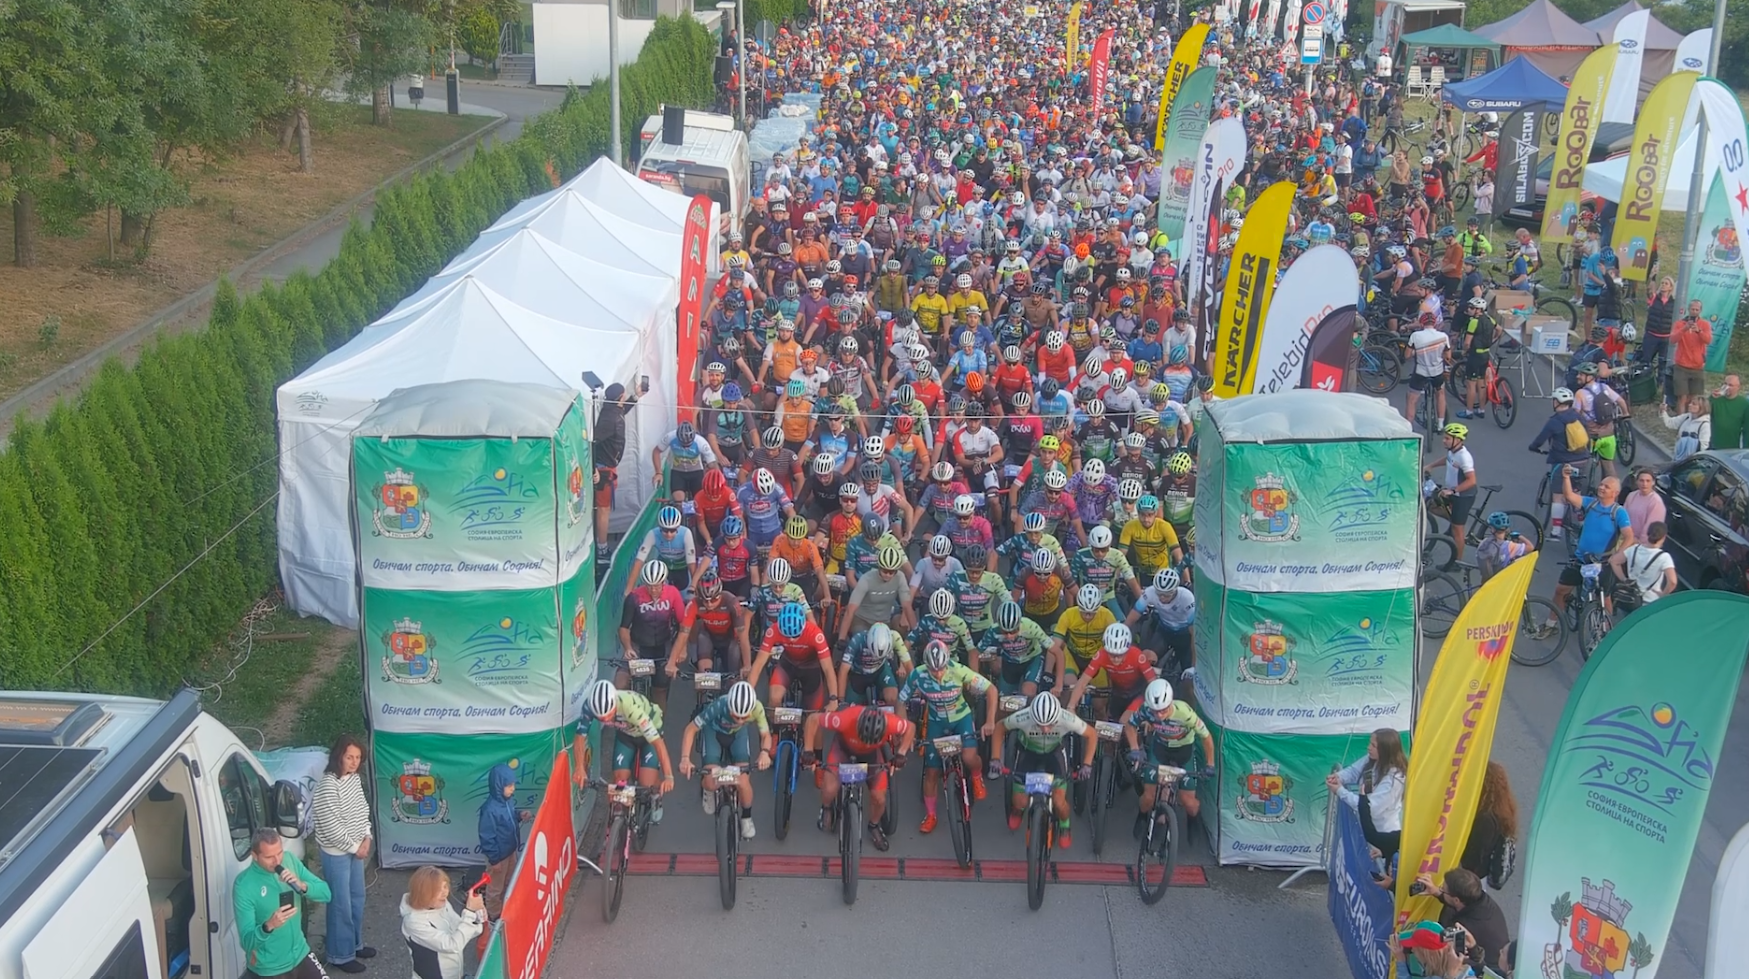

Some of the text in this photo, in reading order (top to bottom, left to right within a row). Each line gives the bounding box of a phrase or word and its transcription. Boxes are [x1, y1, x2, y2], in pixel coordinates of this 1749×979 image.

[1723, 138, 1744, 173] 0.0
[1223, 252, 1257, 388] KÄRCHER
[372, 557, 544, 575] Обичам спорта. Обичам София!
[1236, 559, 1405, 577] Обичам спорта. Обичам София!
[381, 702, 549, 719] Обичам спорта. Обичам София!
[1234, 703, 1400, 719] Обичам спорта. Обичам София!
[1587, 790, 1668, 833] СОФИЯ-ЕВРОПЕЙСКА
[1585, 799, 1665, 844] СТОЛИЦА НА СПОРТА
[392, 843, 430, 854] Обичам
[433, 845, 471, 857] спорта.
[1232, 840, 1272, 851] Обичам
[1274, 842, 1312, 855] спорта.
[1344, 873, 1387, 979] EUROINS
